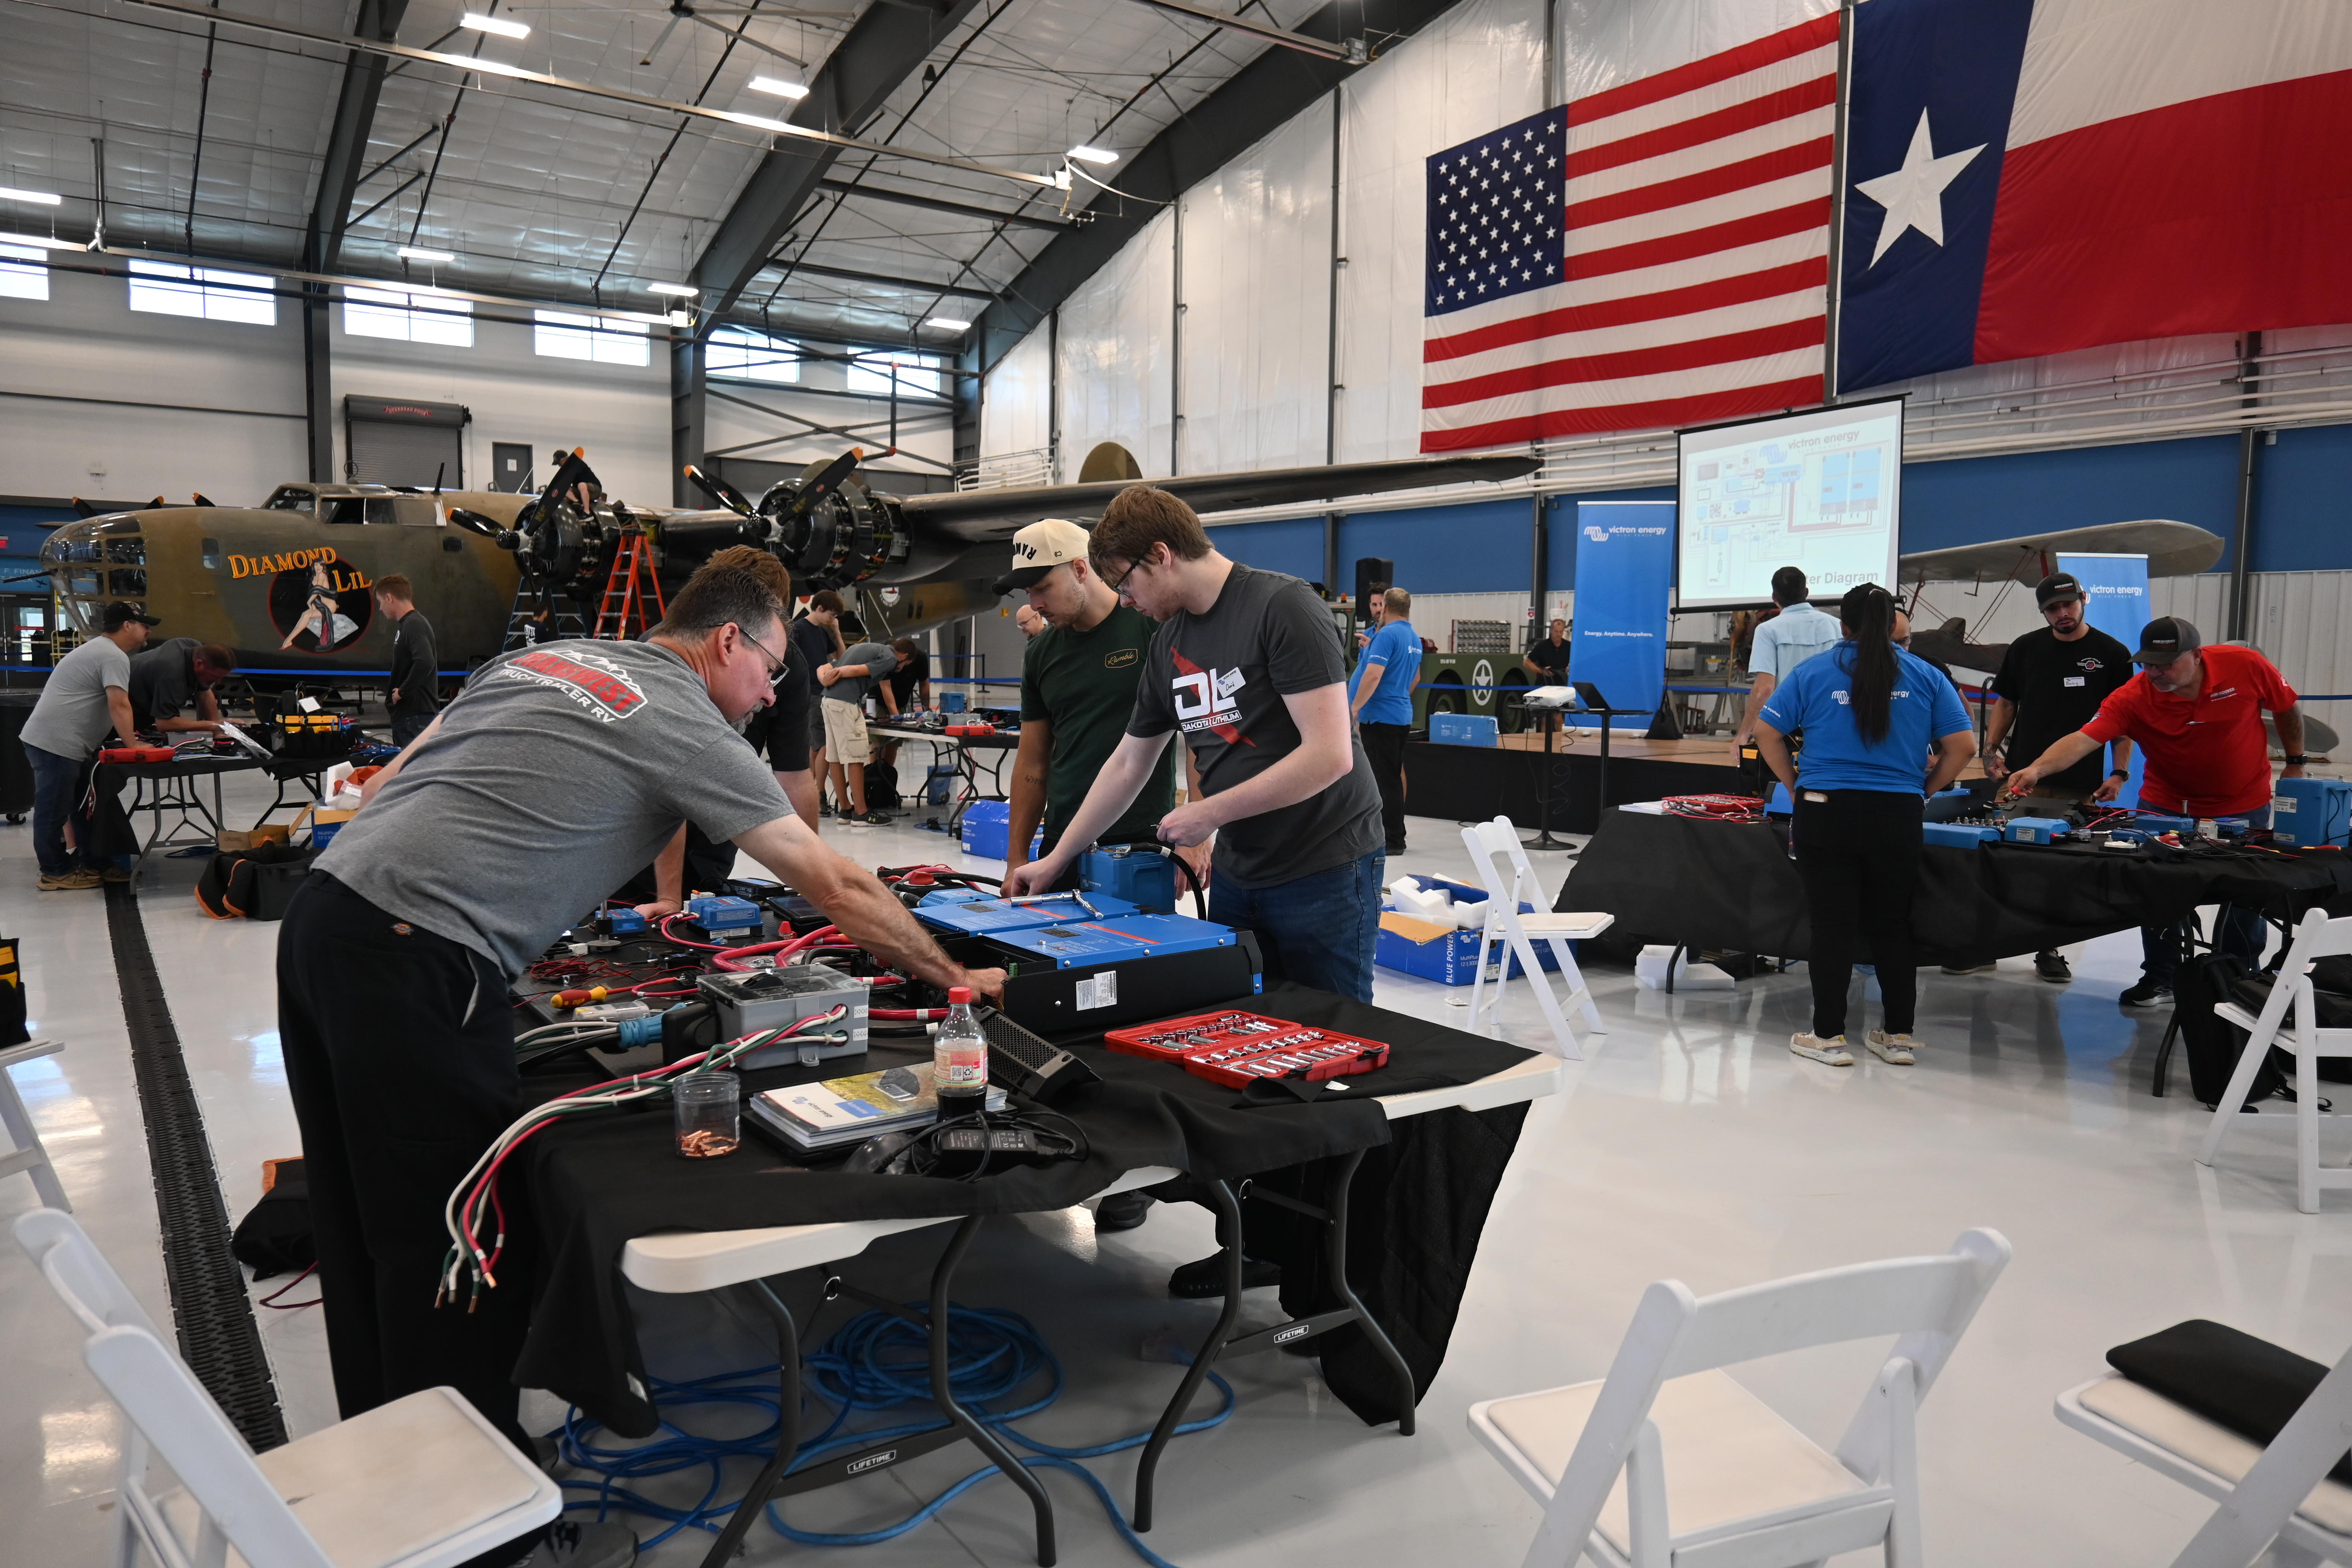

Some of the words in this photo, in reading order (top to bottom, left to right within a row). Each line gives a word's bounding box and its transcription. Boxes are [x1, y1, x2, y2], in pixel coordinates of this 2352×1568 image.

[1788, 436, 1821, 450] victron
[1824, 430, 1860, 443] energy
[1609, 525, 1636, 534] victron
[1638, 527, 1666, 535] energy
[1013, 542, 1037, 560] RAM
[228, 547, 337, 579] DIAMOND
[332, 569, 373, 592] LIL
[1824, 572, 1878, 585] Diagram
[2090, 584, 2115, 593] victron
[2117, 586, 2142, 596] energy
[1108, 651, 1134, 665] Ramble
[1173, 668, 1237, 720] DL
[591, 706, 616, 723] RV
[1183, 719, 1209, 731] DAKOTA
[1212, 712, 1240, 725] LITHIUM
[808, 1102, 821, 1111] victron
[819, 1110, 833, 1118] energy
[1278, 1327, 1305, 1341] LIFETIME
[853, 1453, 890, 1471] LIFETIME
